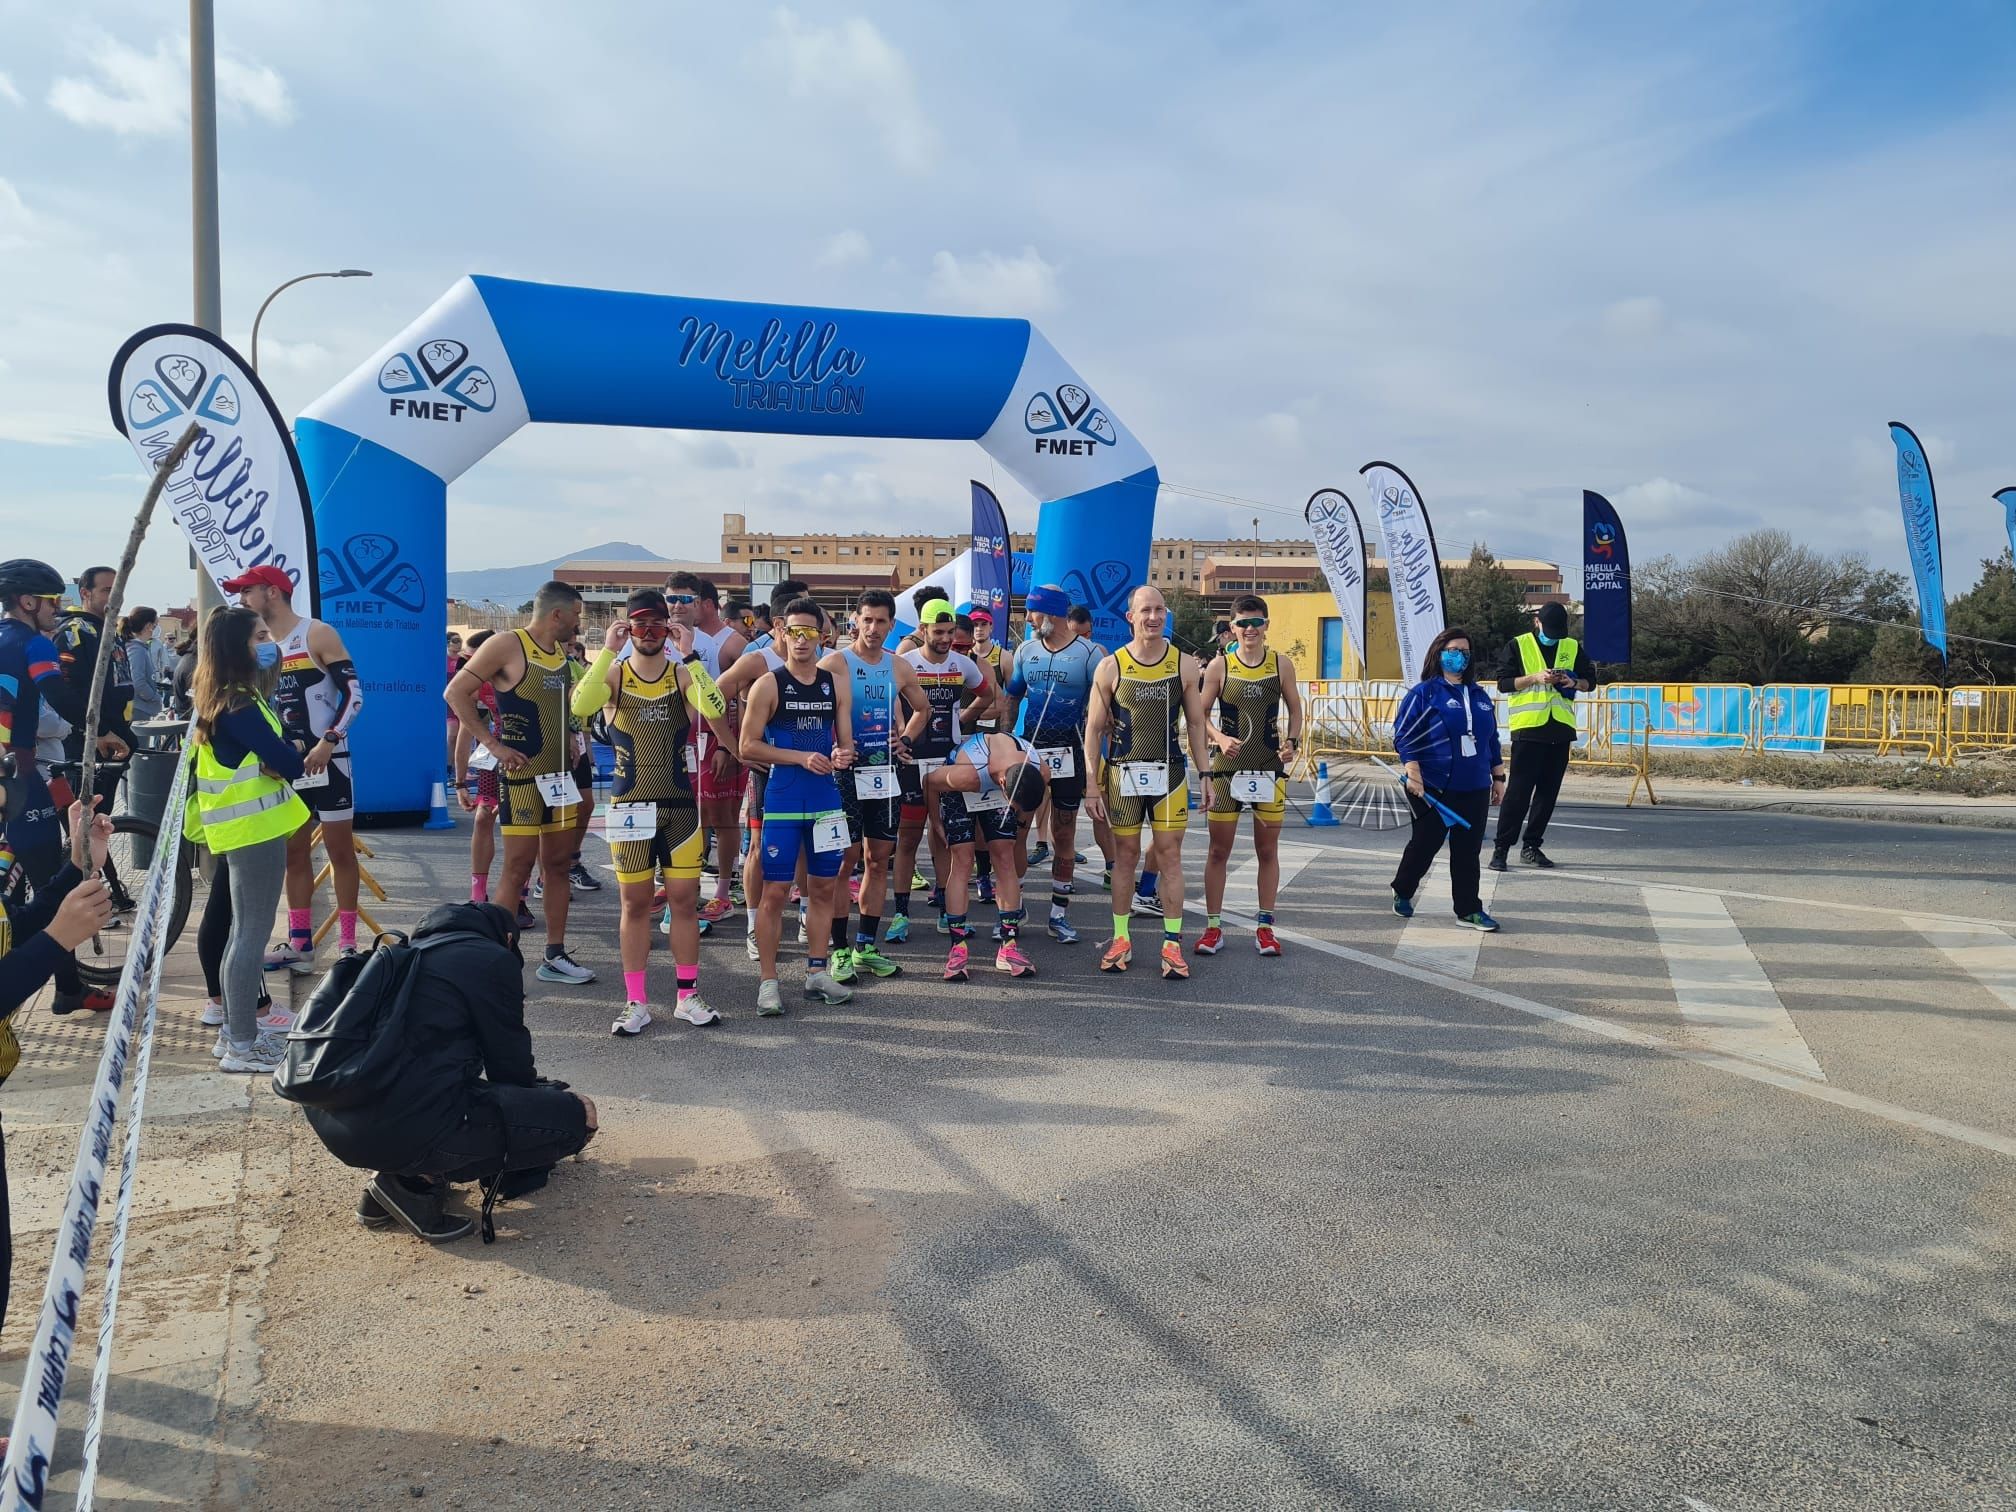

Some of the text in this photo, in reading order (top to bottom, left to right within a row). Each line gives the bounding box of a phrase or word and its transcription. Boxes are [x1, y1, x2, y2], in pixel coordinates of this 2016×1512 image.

[678, 316, 866, 384] Melilla
[730, 376, 865, 415] TRIATLÓN
[390, 398, 468, 423] FMET
[1035, 438, 1097, 456] FMET
[1585, 563, 1621, 572] MELILLA
[1585, 572, 1615, 581] SPORT
[1585, 581, 1622, 590] CAPITAL
[335, 601, 387, 614] FMET
[1093, 617, 1118, 628] MET
[865, 685, 885, 700] RUIZ
[926, 687, 954, 700] MBRODA
[873, 777, 882, 789] 8
[1139, 773, 1149, 786] 5
[550, 784, 567, 797] 11
[1248, 781, 1257, 793] 3
[624, 815, 635, 830] 4
[831, 826, 841, 840] 1
